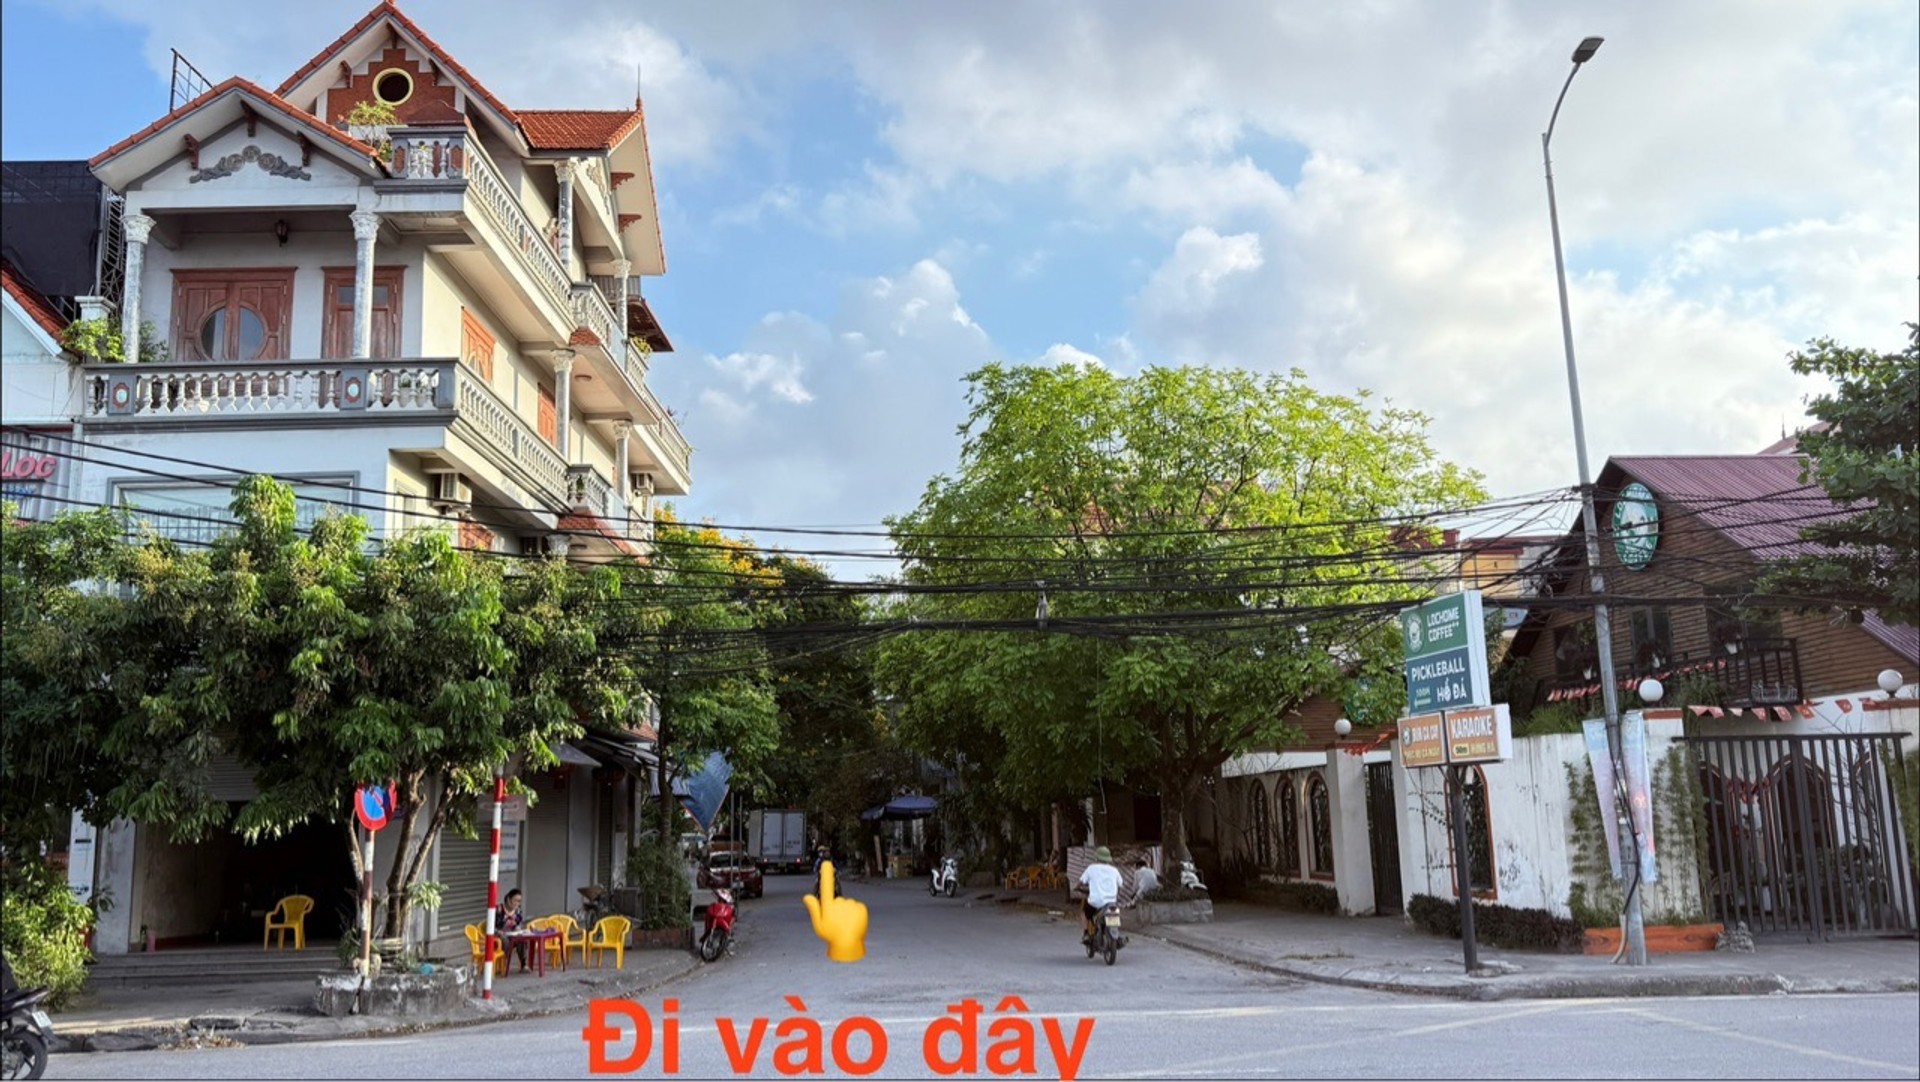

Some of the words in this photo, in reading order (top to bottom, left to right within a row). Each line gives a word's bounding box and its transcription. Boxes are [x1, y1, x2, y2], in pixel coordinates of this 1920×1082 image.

[1412, 658, 1465, 681] PICKLEBALL
[1453, 677, 1467, 700] ĐÁ
[1451, 716, 1493, 739] KARAOKE
